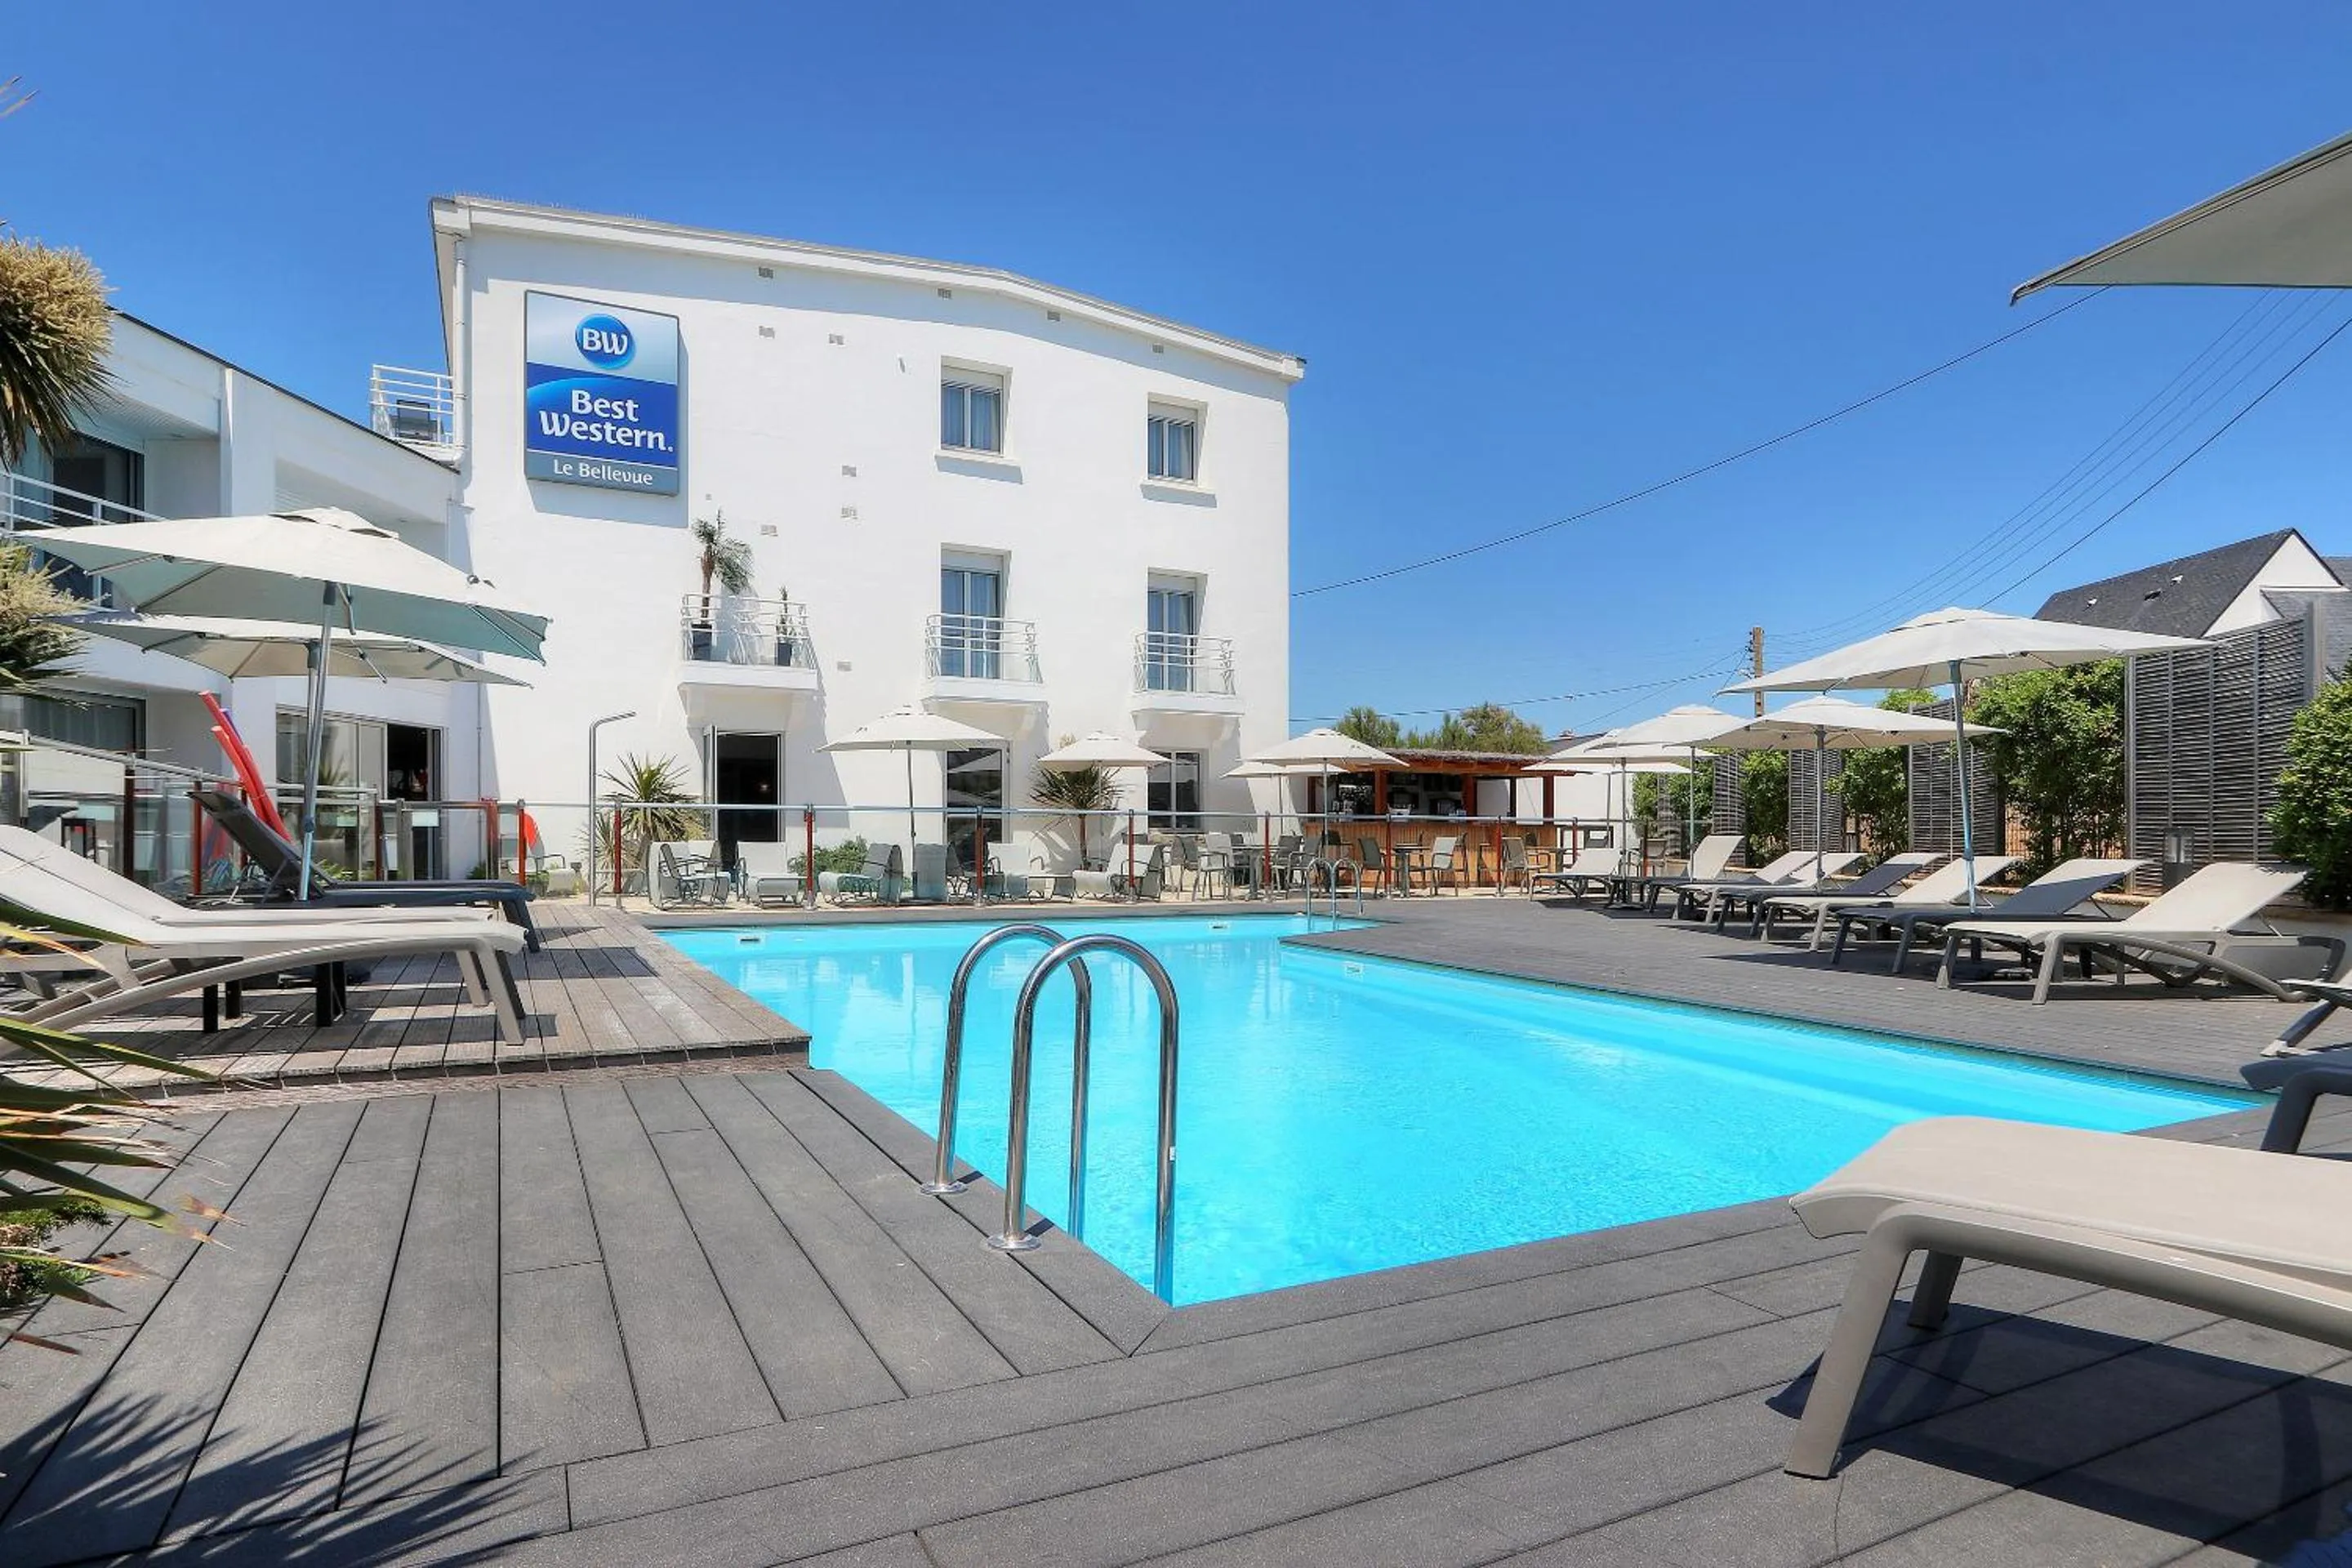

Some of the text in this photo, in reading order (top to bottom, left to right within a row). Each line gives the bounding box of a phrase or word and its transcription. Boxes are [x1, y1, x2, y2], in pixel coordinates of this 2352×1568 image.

[582, 328, 628, 355] BW
[572, 390, 639, 422] Best
[553, 459, 653, 486] Le Bellevue
